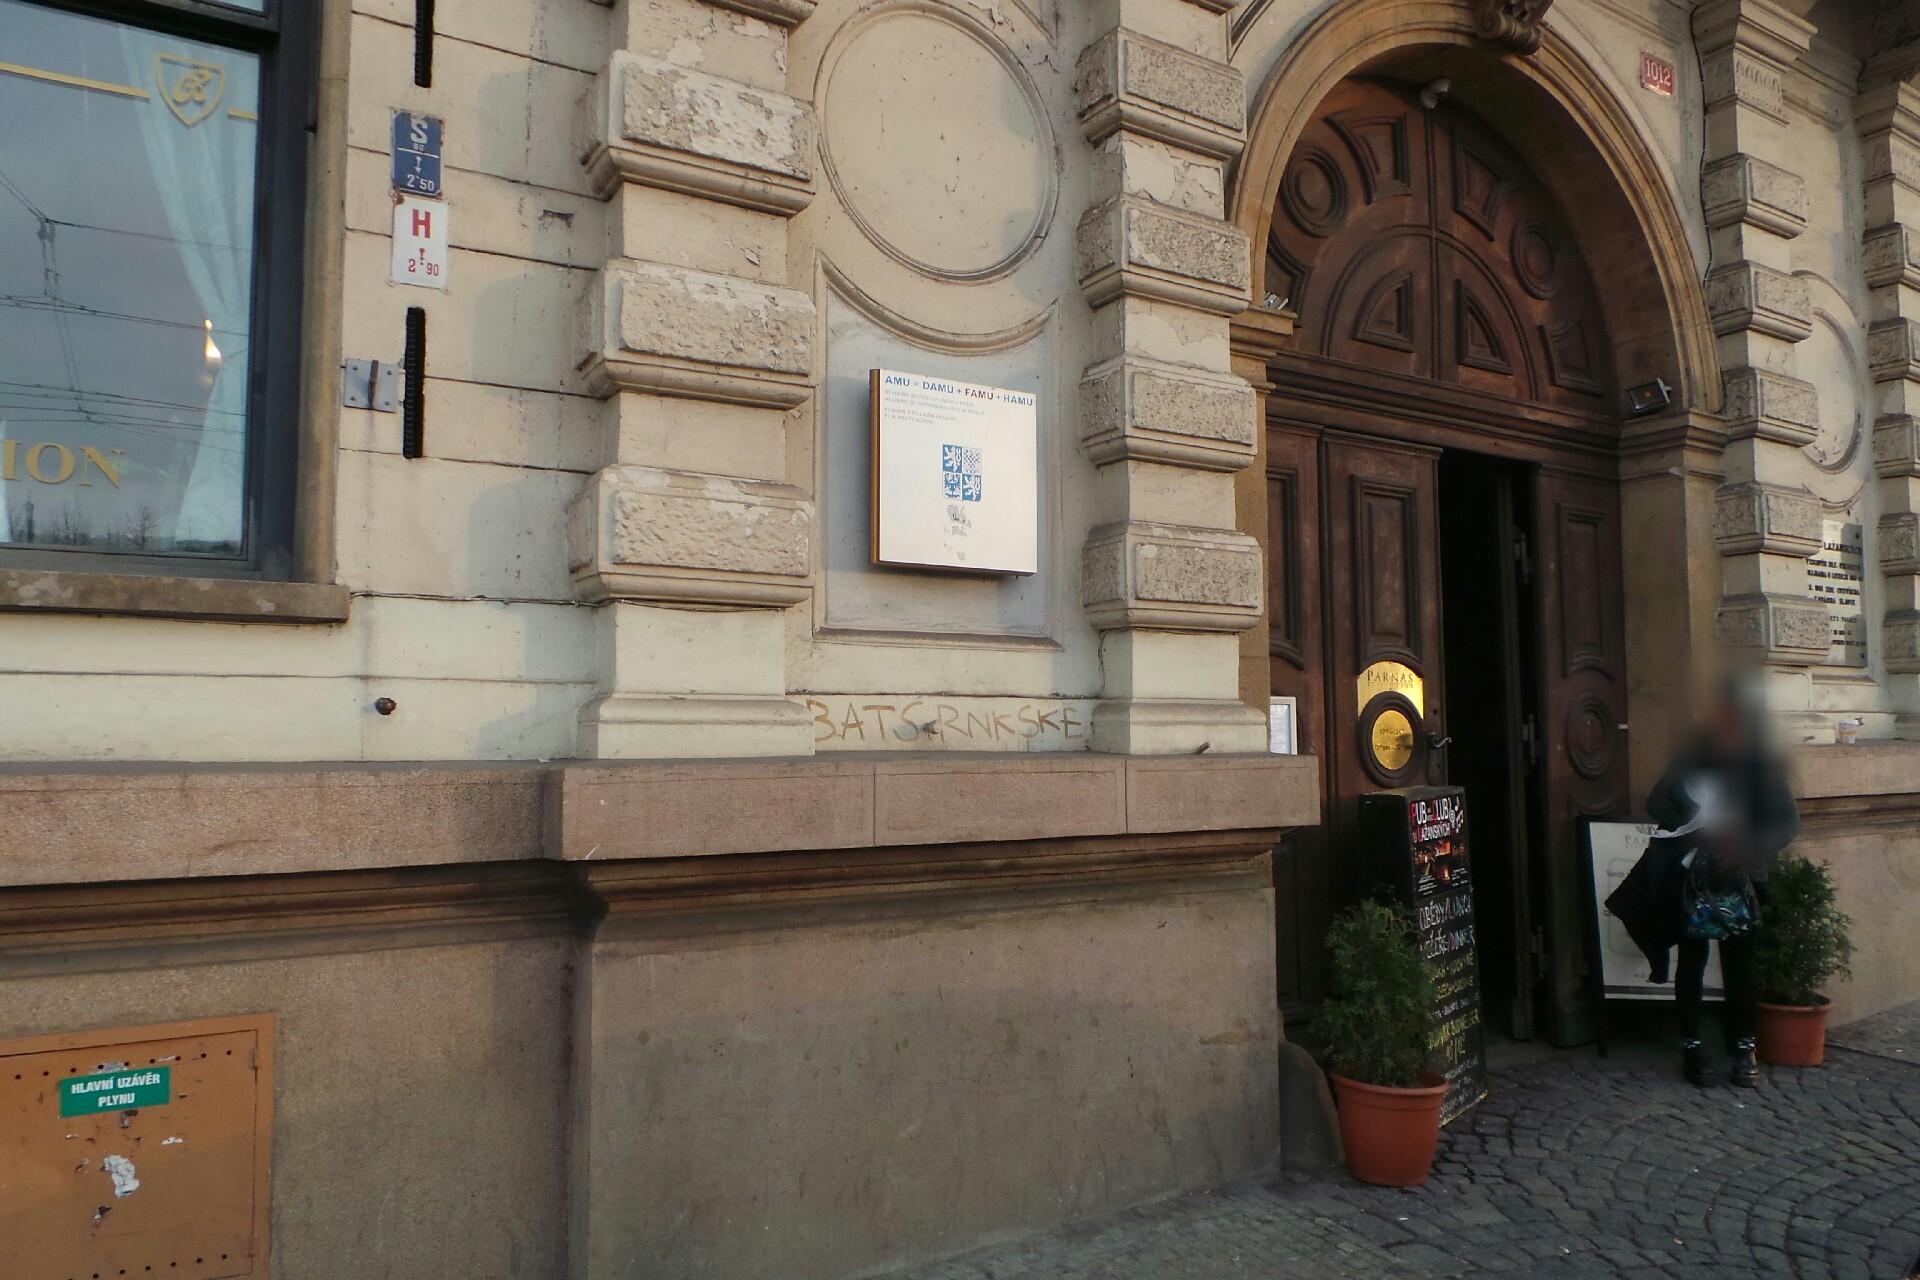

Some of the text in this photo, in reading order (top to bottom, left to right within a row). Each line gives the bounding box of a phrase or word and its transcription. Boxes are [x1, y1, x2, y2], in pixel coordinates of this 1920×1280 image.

[1646, 59, 1671, 86] 1012
[410, 118, 428, 144] S
[412, 208, 432, 239] H
[885, 375, 911, 387] AMU
[922, 381, 954, 394] DAMU
[965, 388, 994, 400] FAMU
[1003, 394, 1034, 407] HAMU
[1367, 669, 1414, 683] PARNAS
[1411, 801, 1427, 825] PUB
[1432, 798, 1448, 823] CLUB
[71, 1072, 161, 1095] HLAVNÍ UZÁVĚR
[97, 1092, 136, 1108] PLYNU
